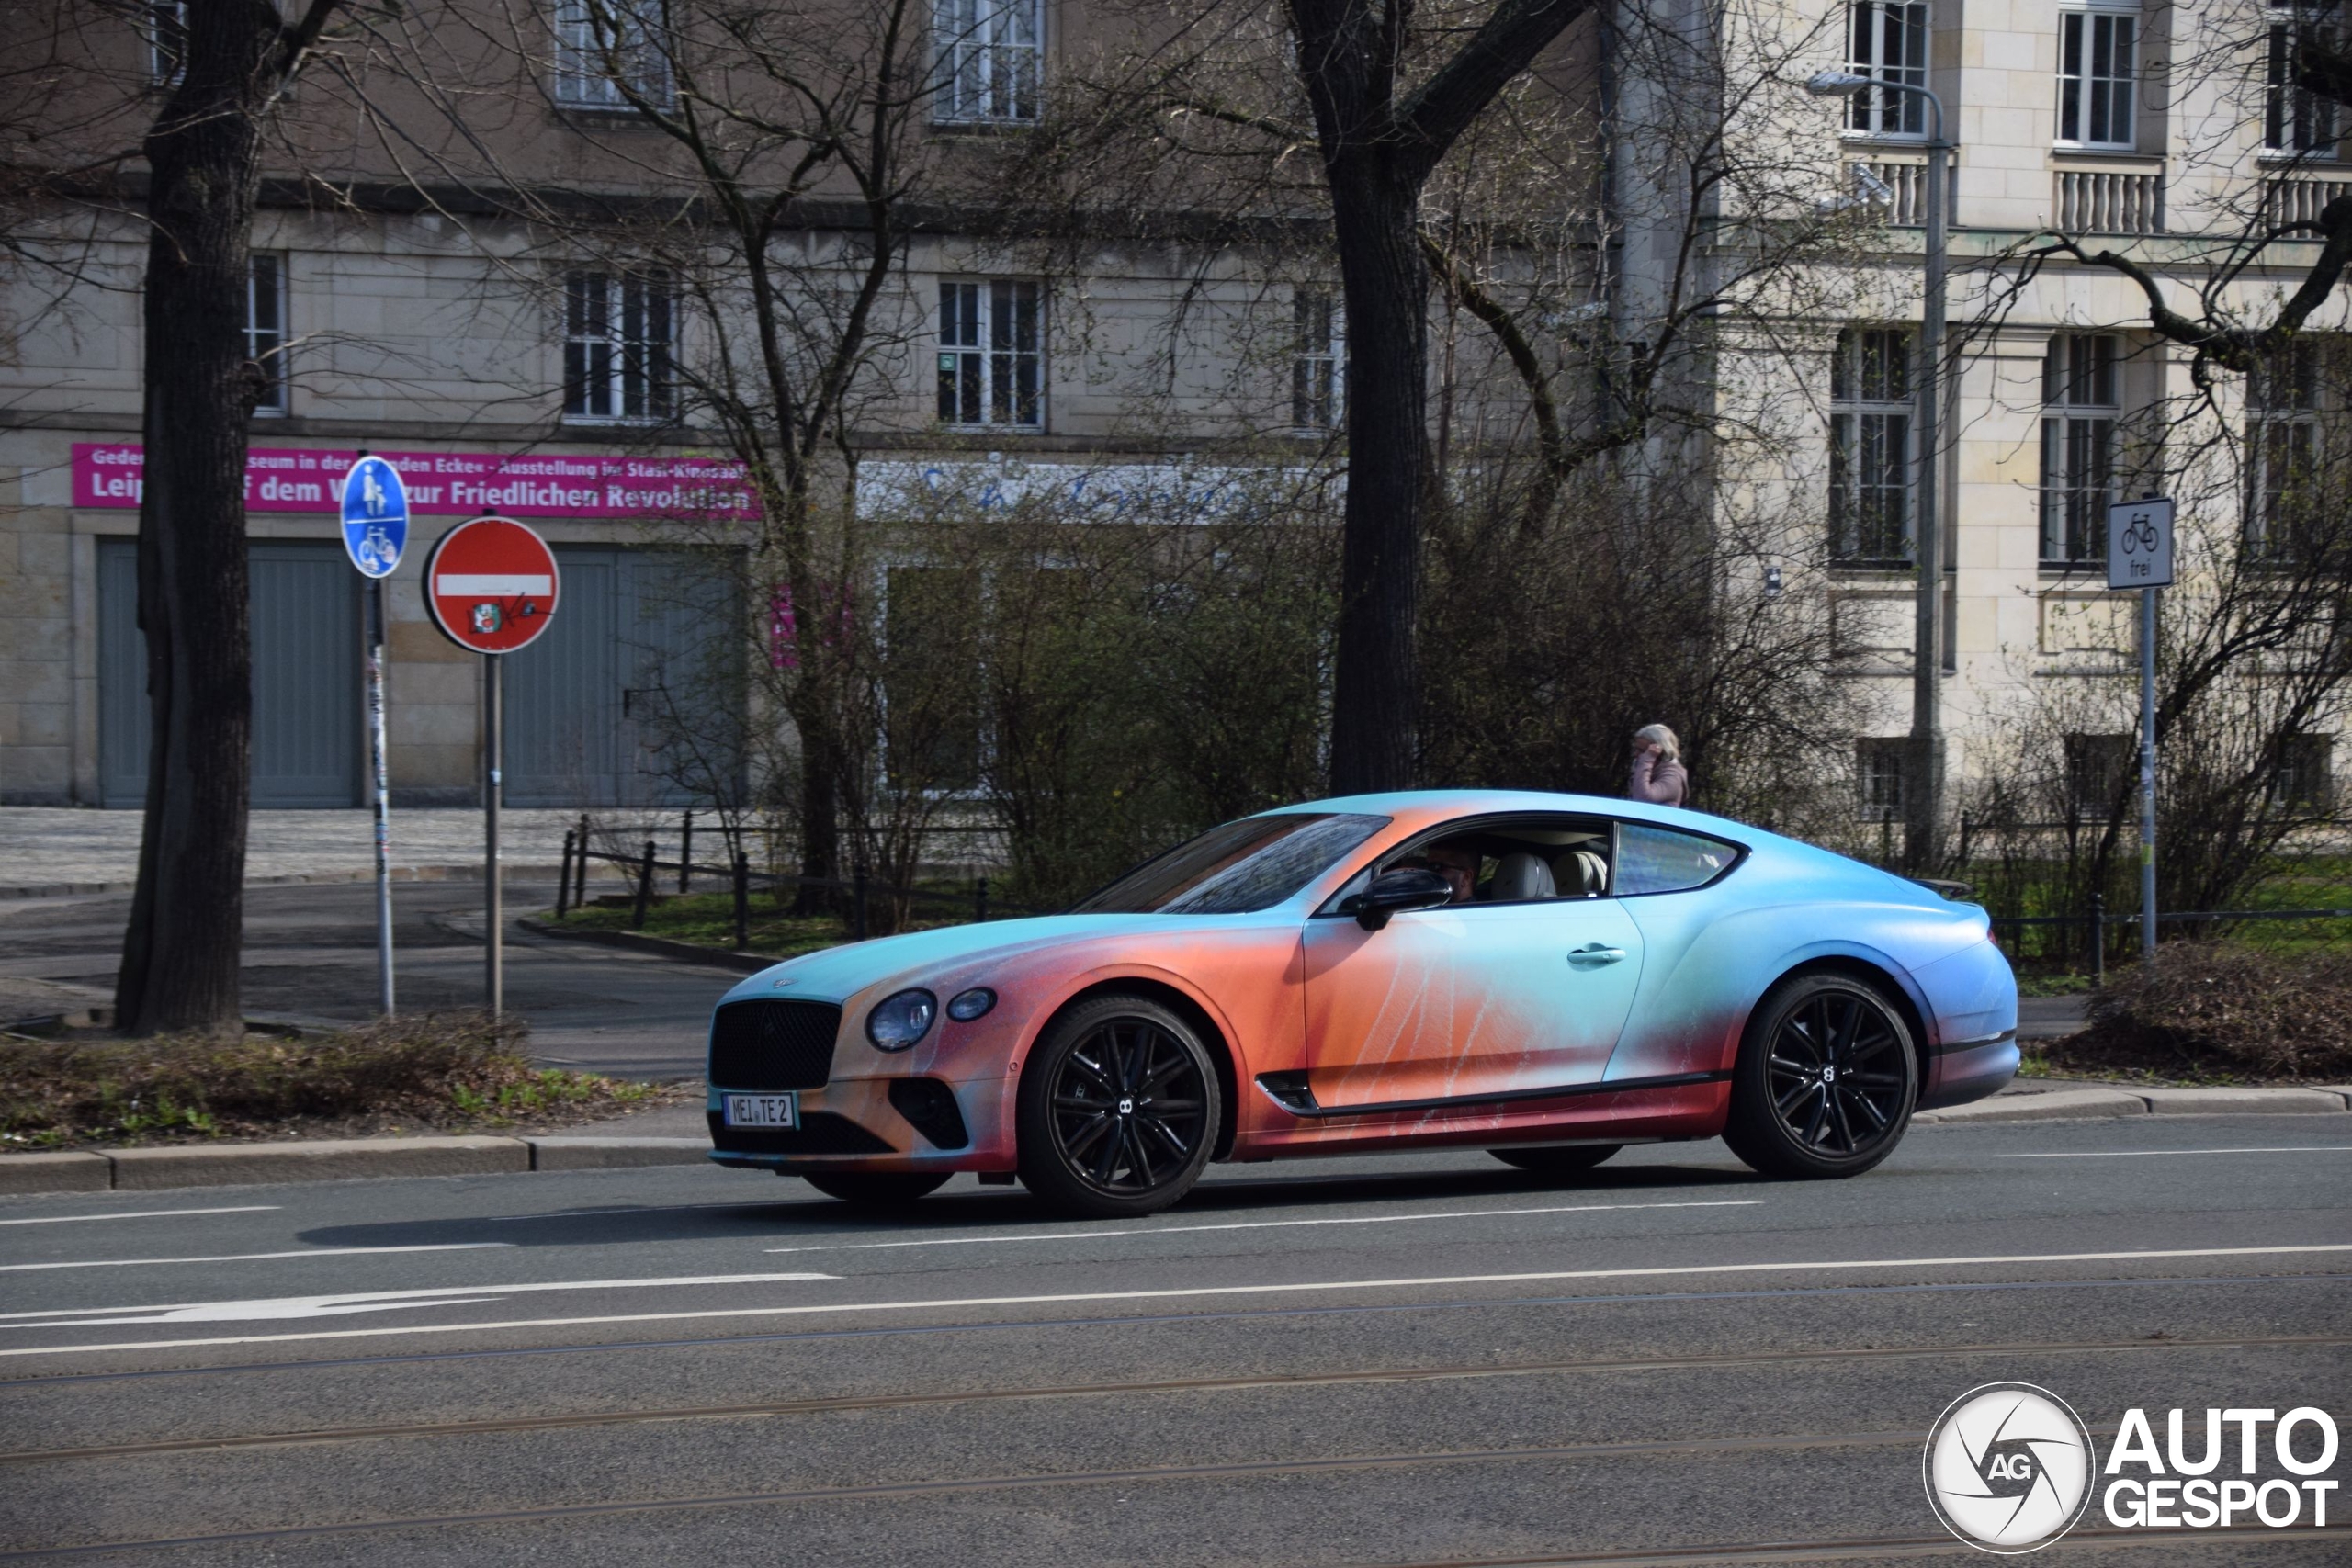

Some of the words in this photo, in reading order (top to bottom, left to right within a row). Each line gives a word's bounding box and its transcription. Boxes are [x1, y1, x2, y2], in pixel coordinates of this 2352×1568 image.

[244, 456, 295, 470] seum
[299, 455, 317, 470] in
[322, 456, 351, 471] der
[498, 460, 596, 479] Ausstellung
[260, 476, 322, 502] dem
[405, 486, 443, 504] zur
[451, 481, 599, 507] Friedlichen
[607, 484, 750, 510] Revolution
[2131, 558, 2151, 577] frei
[732, 1099, 753, 1123] MEI
[760, 1099, 777, 1123] TE
[778, 1099, 787, 1123] 2
